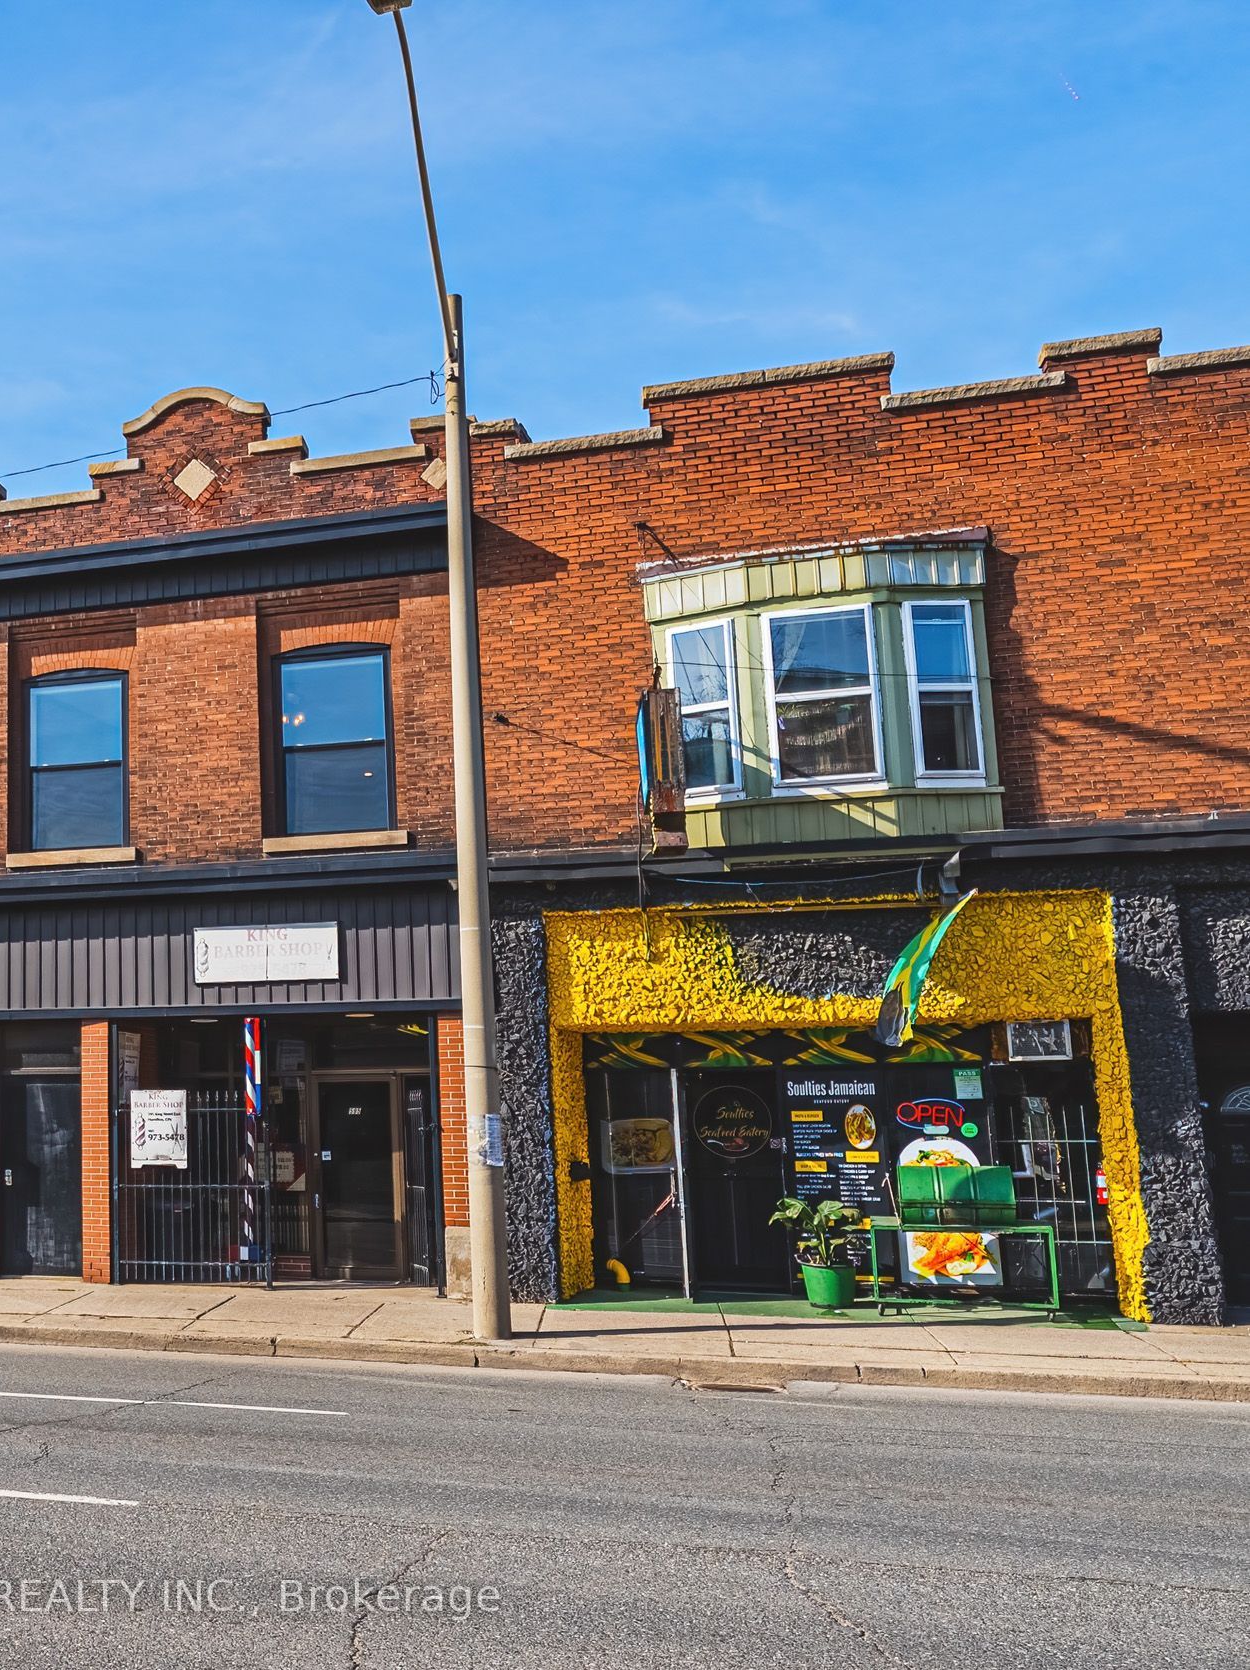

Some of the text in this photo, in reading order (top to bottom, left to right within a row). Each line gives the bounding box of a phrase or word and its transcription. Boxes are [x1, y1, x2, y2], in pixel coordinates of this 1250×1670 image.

[246, 928, 288, 942] KING
[214, 942, 322, 960] BARBER SHOP
[787, 1080, 876, 1096] Soulties Jamaican
[897, 1102, 963, 1127] OPEN
[738, 1125, 769, 1139] Eatery
